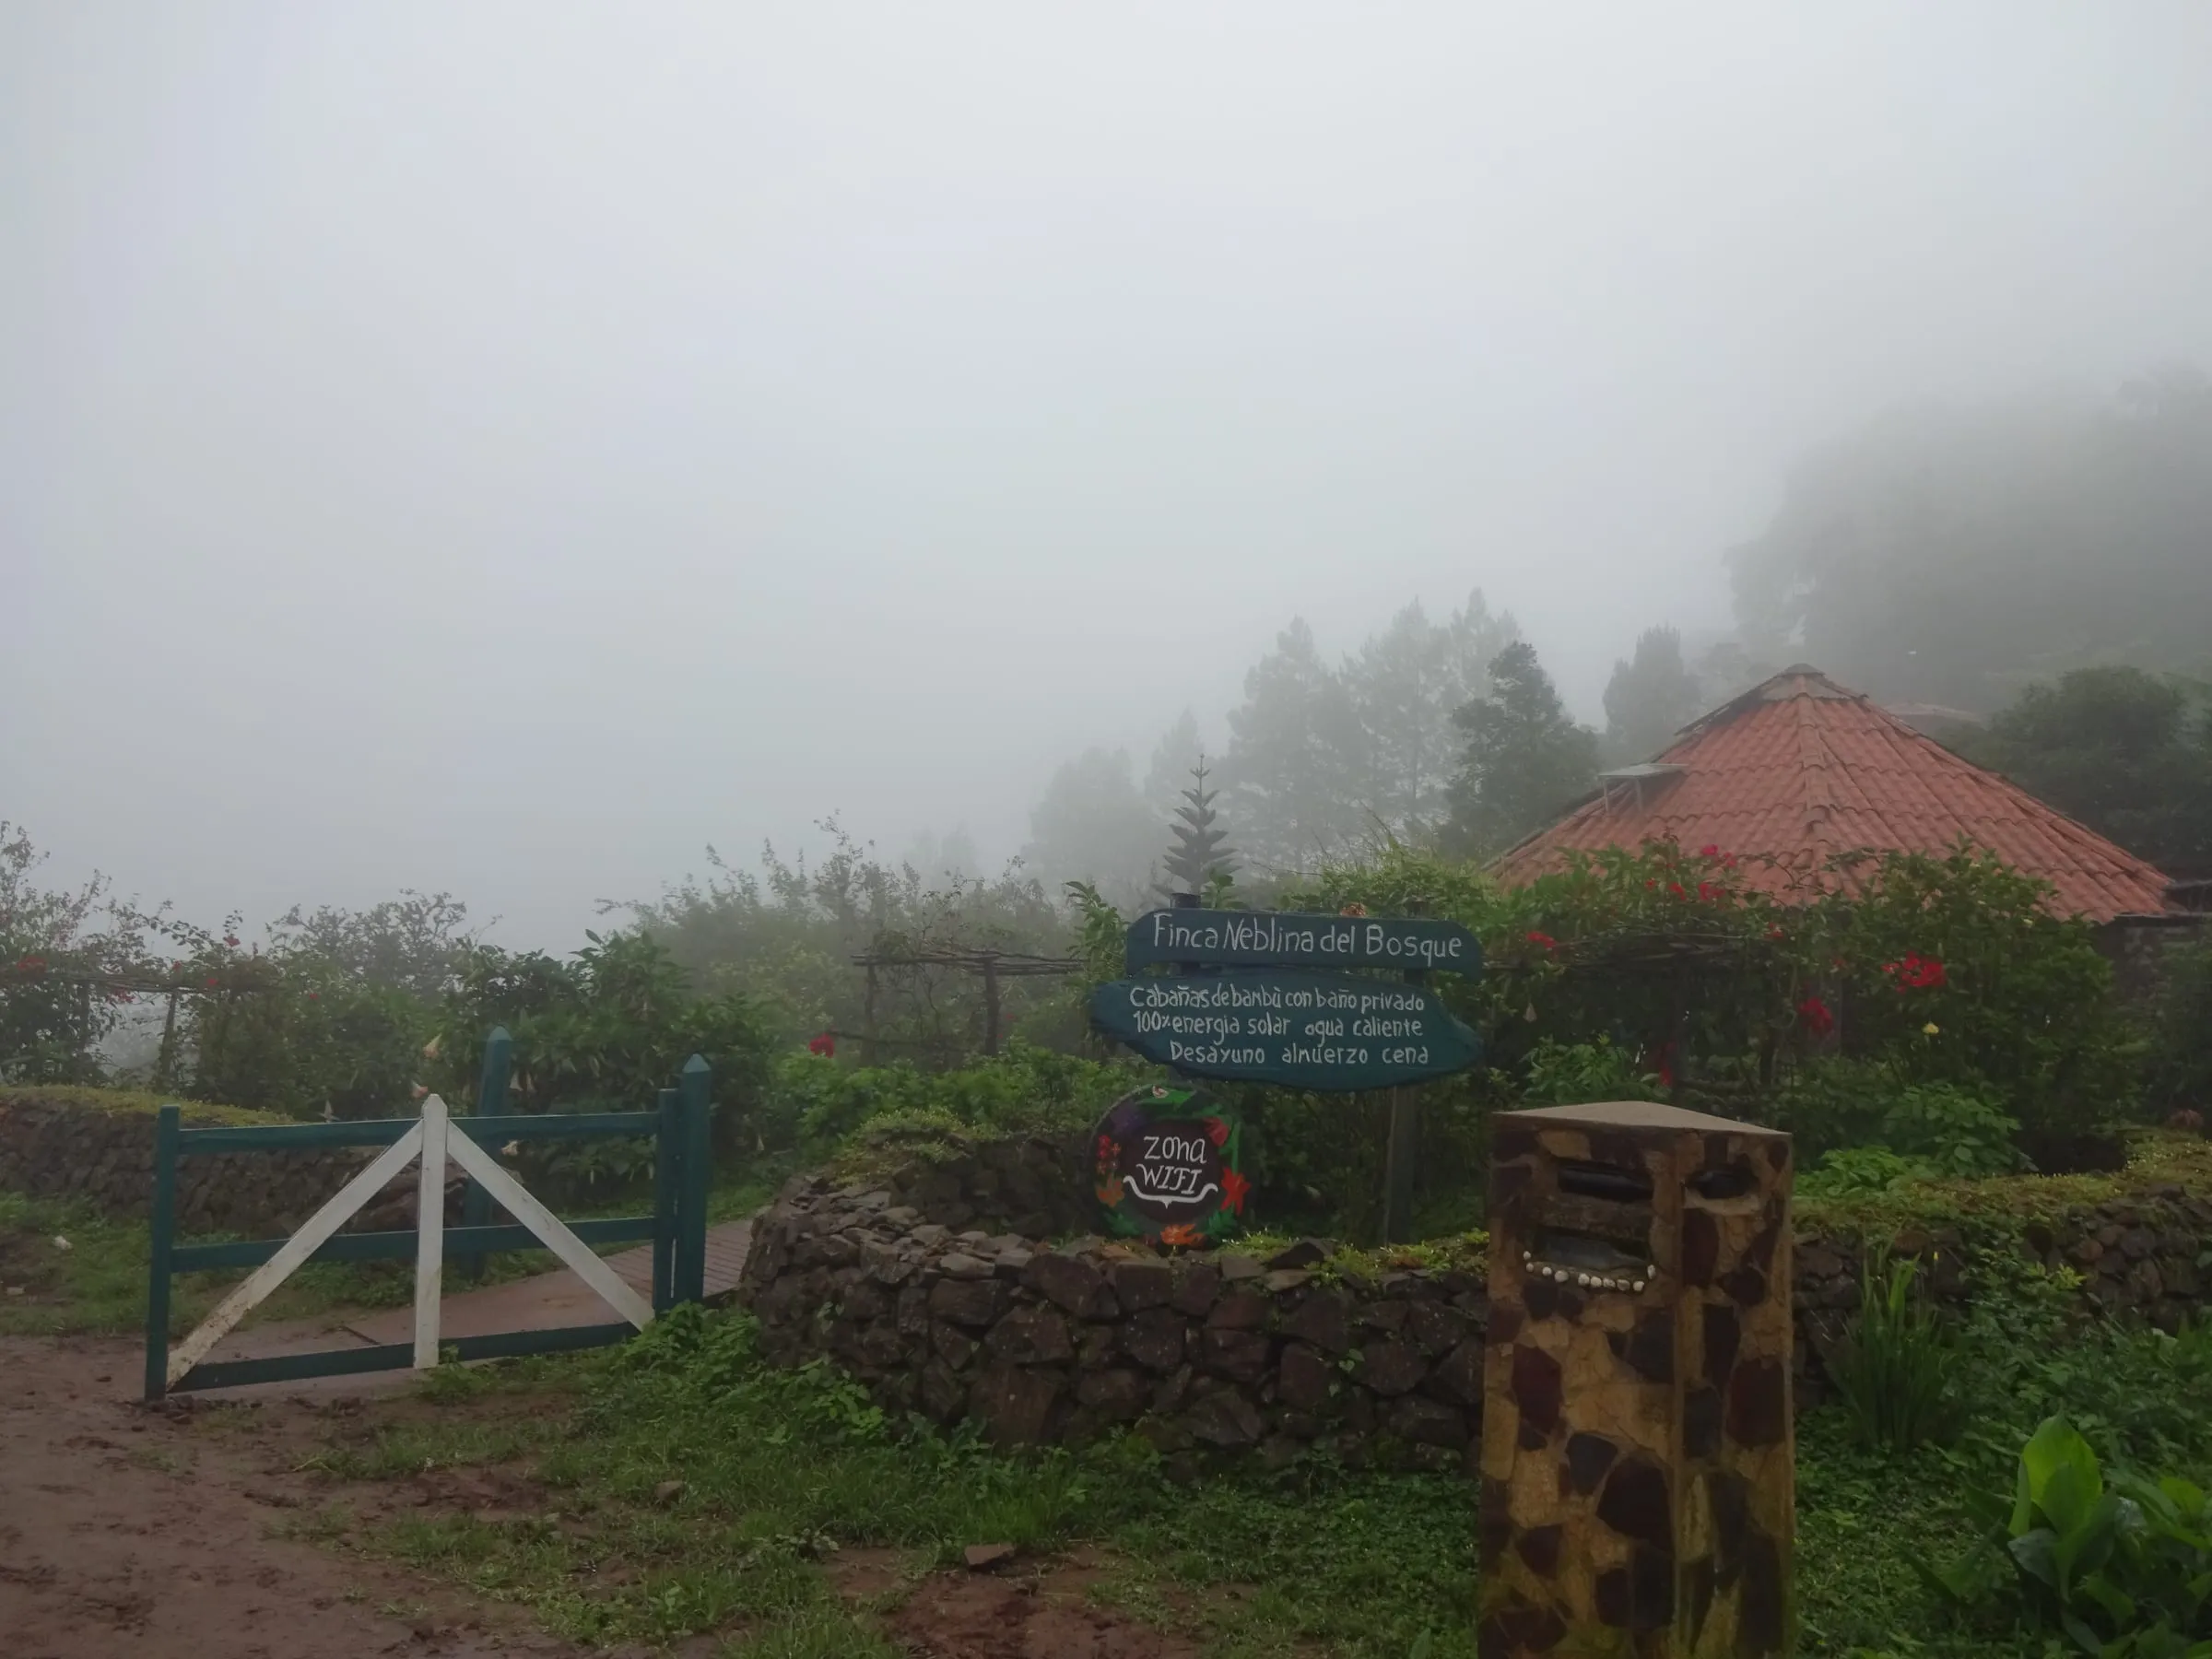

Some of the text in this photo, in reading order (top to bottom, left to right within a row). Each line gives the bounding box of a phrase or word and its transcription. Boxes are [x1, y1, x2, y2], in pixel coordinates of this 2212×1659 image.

[1153, 912, 1462, 967] Finca Neblina del Bosque
[1211, 982, 1230, 1007] de
[1285, 989, 1312, 1008] con
[1314, 986, 1358, 1010] baño
[1360, 992, 1425, 1015] privado
[1247, 1011, 1291, 1037] solar
[1304, 1018, 1345, 1048] agua
[1352, 1015, 1424, 1038] caliente
[1170, 1039, 1430, 1065] Desayuno almuerzo cena
